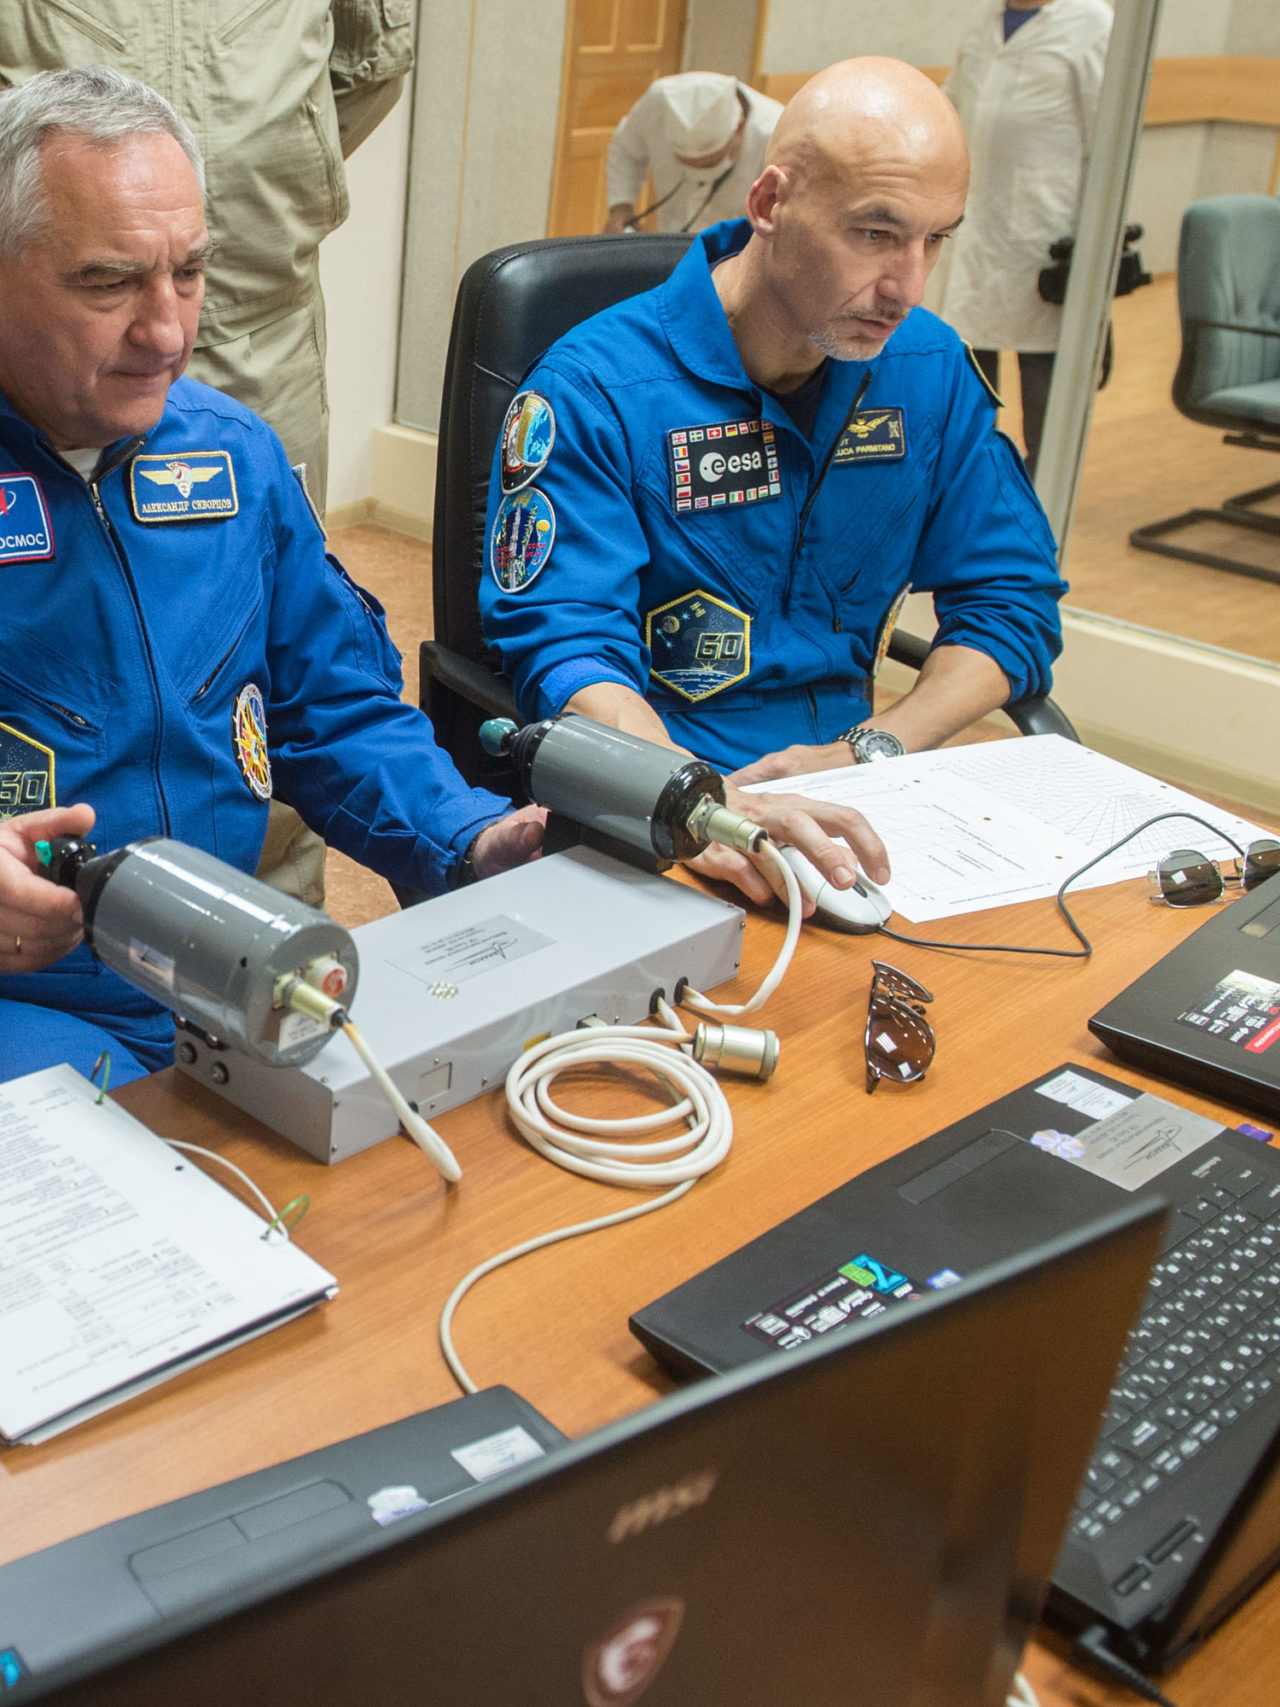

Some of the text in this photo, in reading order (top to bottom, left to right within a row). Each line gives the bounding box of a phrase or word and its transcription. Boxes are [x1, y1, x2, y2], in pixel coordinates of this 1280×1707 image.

[855, 443, 897, 453] PARMITANO
[727, 450, 763, 474] esa
[141, 498, 233, 514] АЛЕКСАНДР СКВОРЦОВ
[694, 632, 745, 660] 60
